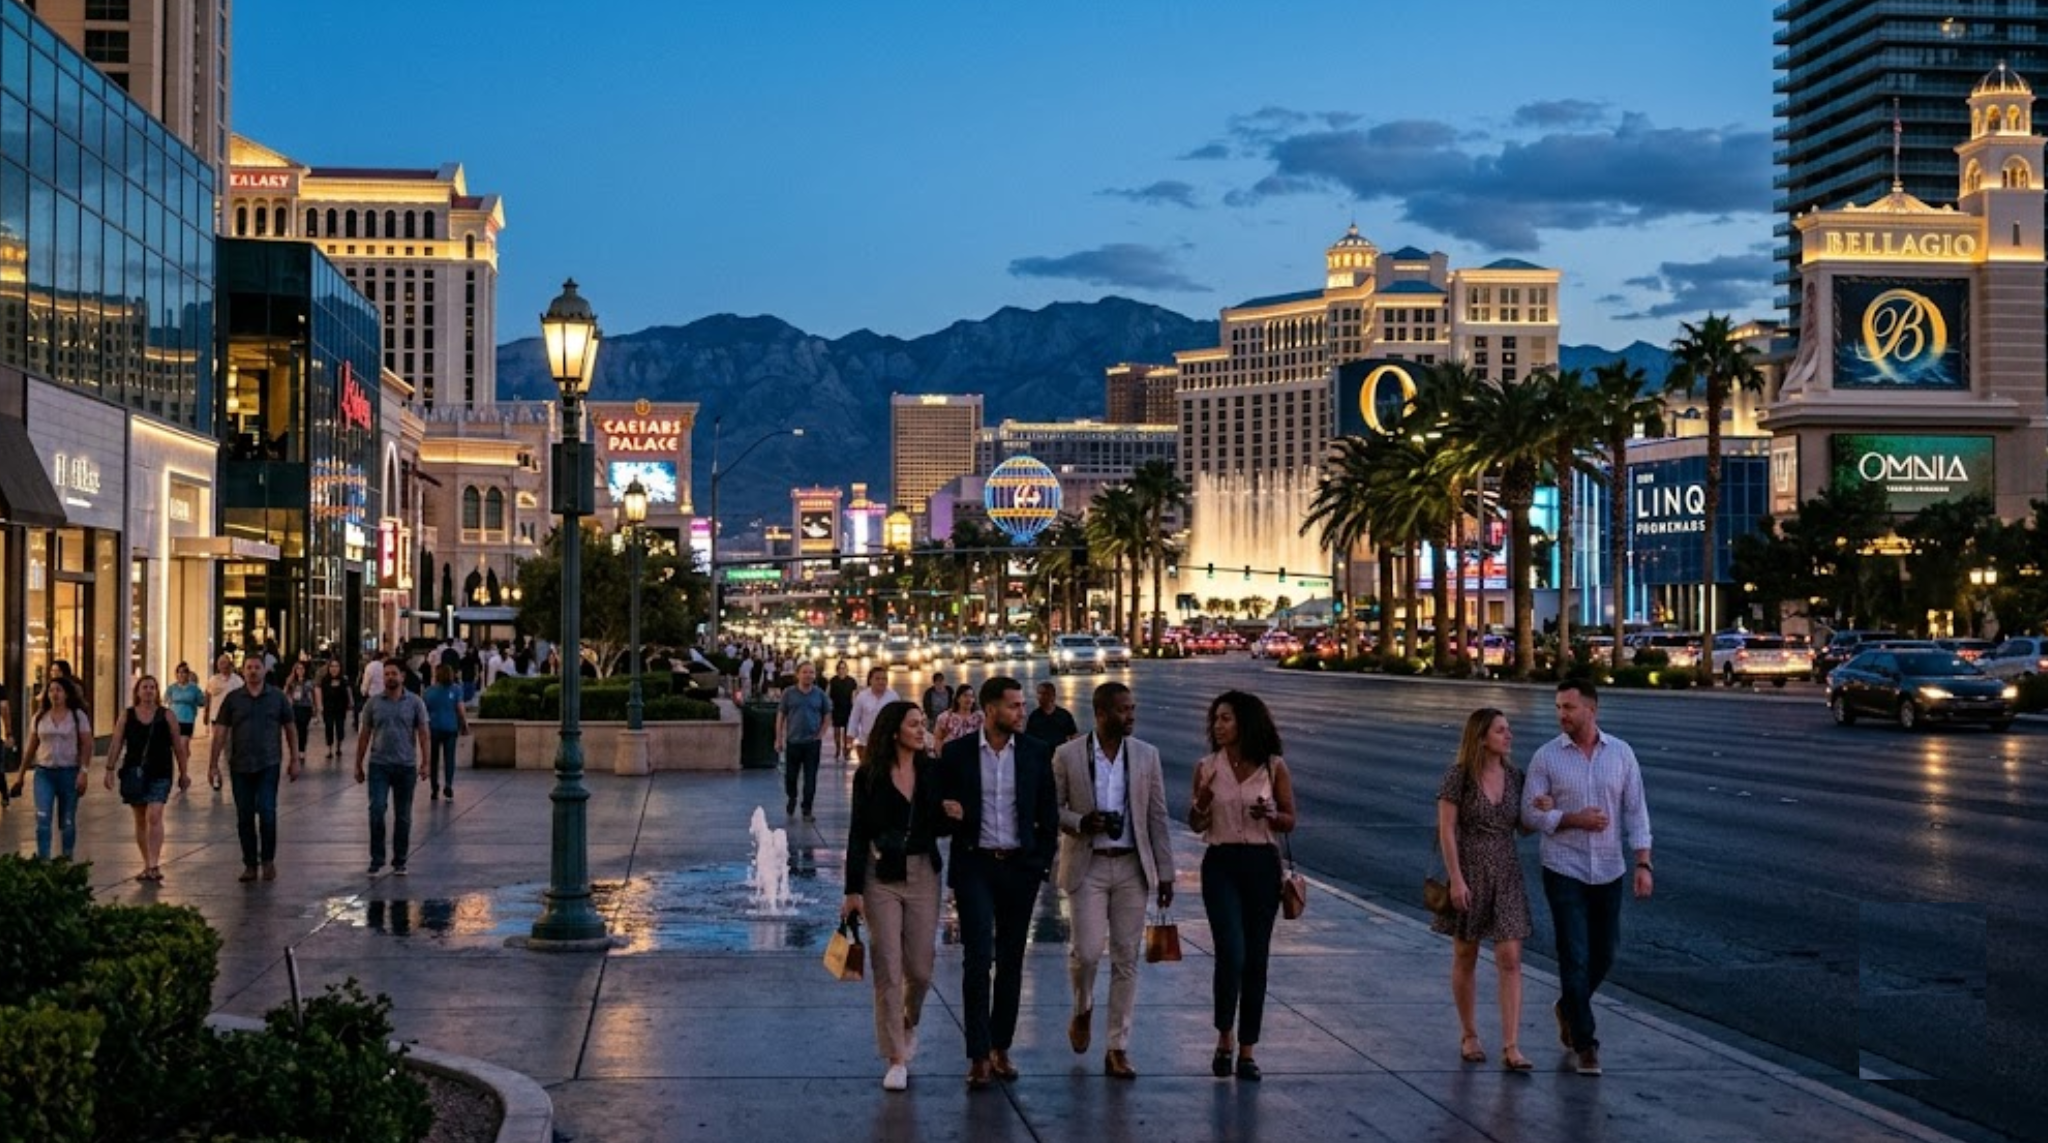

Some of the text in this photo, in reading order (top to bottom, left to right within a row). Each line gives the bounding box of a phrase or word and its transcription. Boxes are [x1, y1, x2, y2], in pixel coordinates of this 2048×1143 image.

[1825, 232, 1976, 256] BELLAGIO
[608, 436, 678, 451] PALACE
[1858, 451, 1969, 481] OMNIA
[1637, 485, 1706, 518] LINQ
